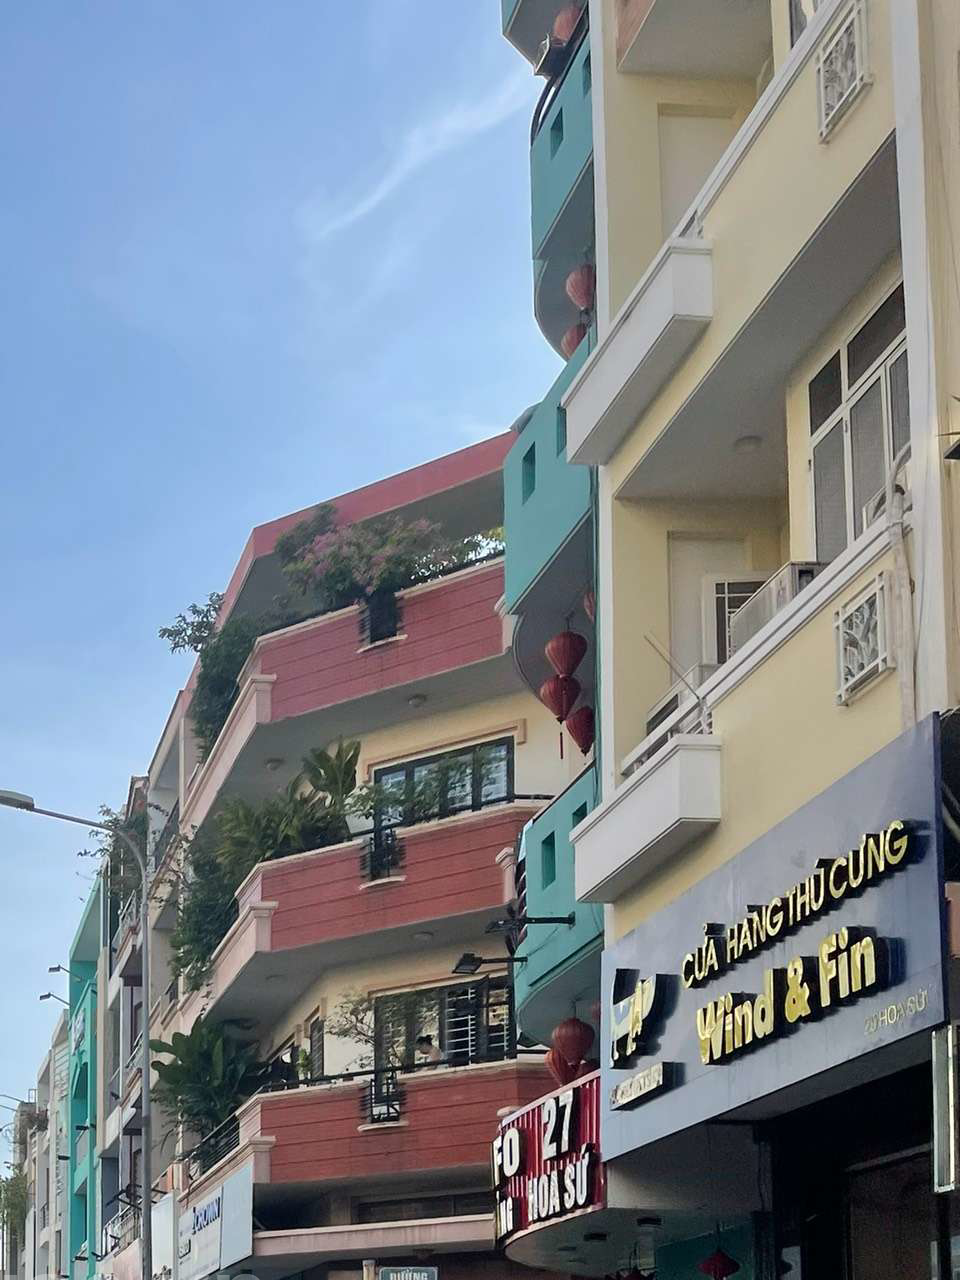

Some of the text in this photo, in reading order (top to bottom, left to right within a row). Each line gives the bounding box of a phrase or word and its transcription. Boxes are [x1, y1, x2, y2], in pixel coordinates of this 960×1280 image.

[682, 923, 719, 988] CỬA
[727, 897, 784, 964] HÀNG
[829, 820, 909, 898] CƯNG
[696, 927, 876, 1064] Wind & Fin
[543, 1088, 574, 1160] 27
[528, 1169, 560, 1222] HOA
[564, 1143, 590, 1209] SỨ
